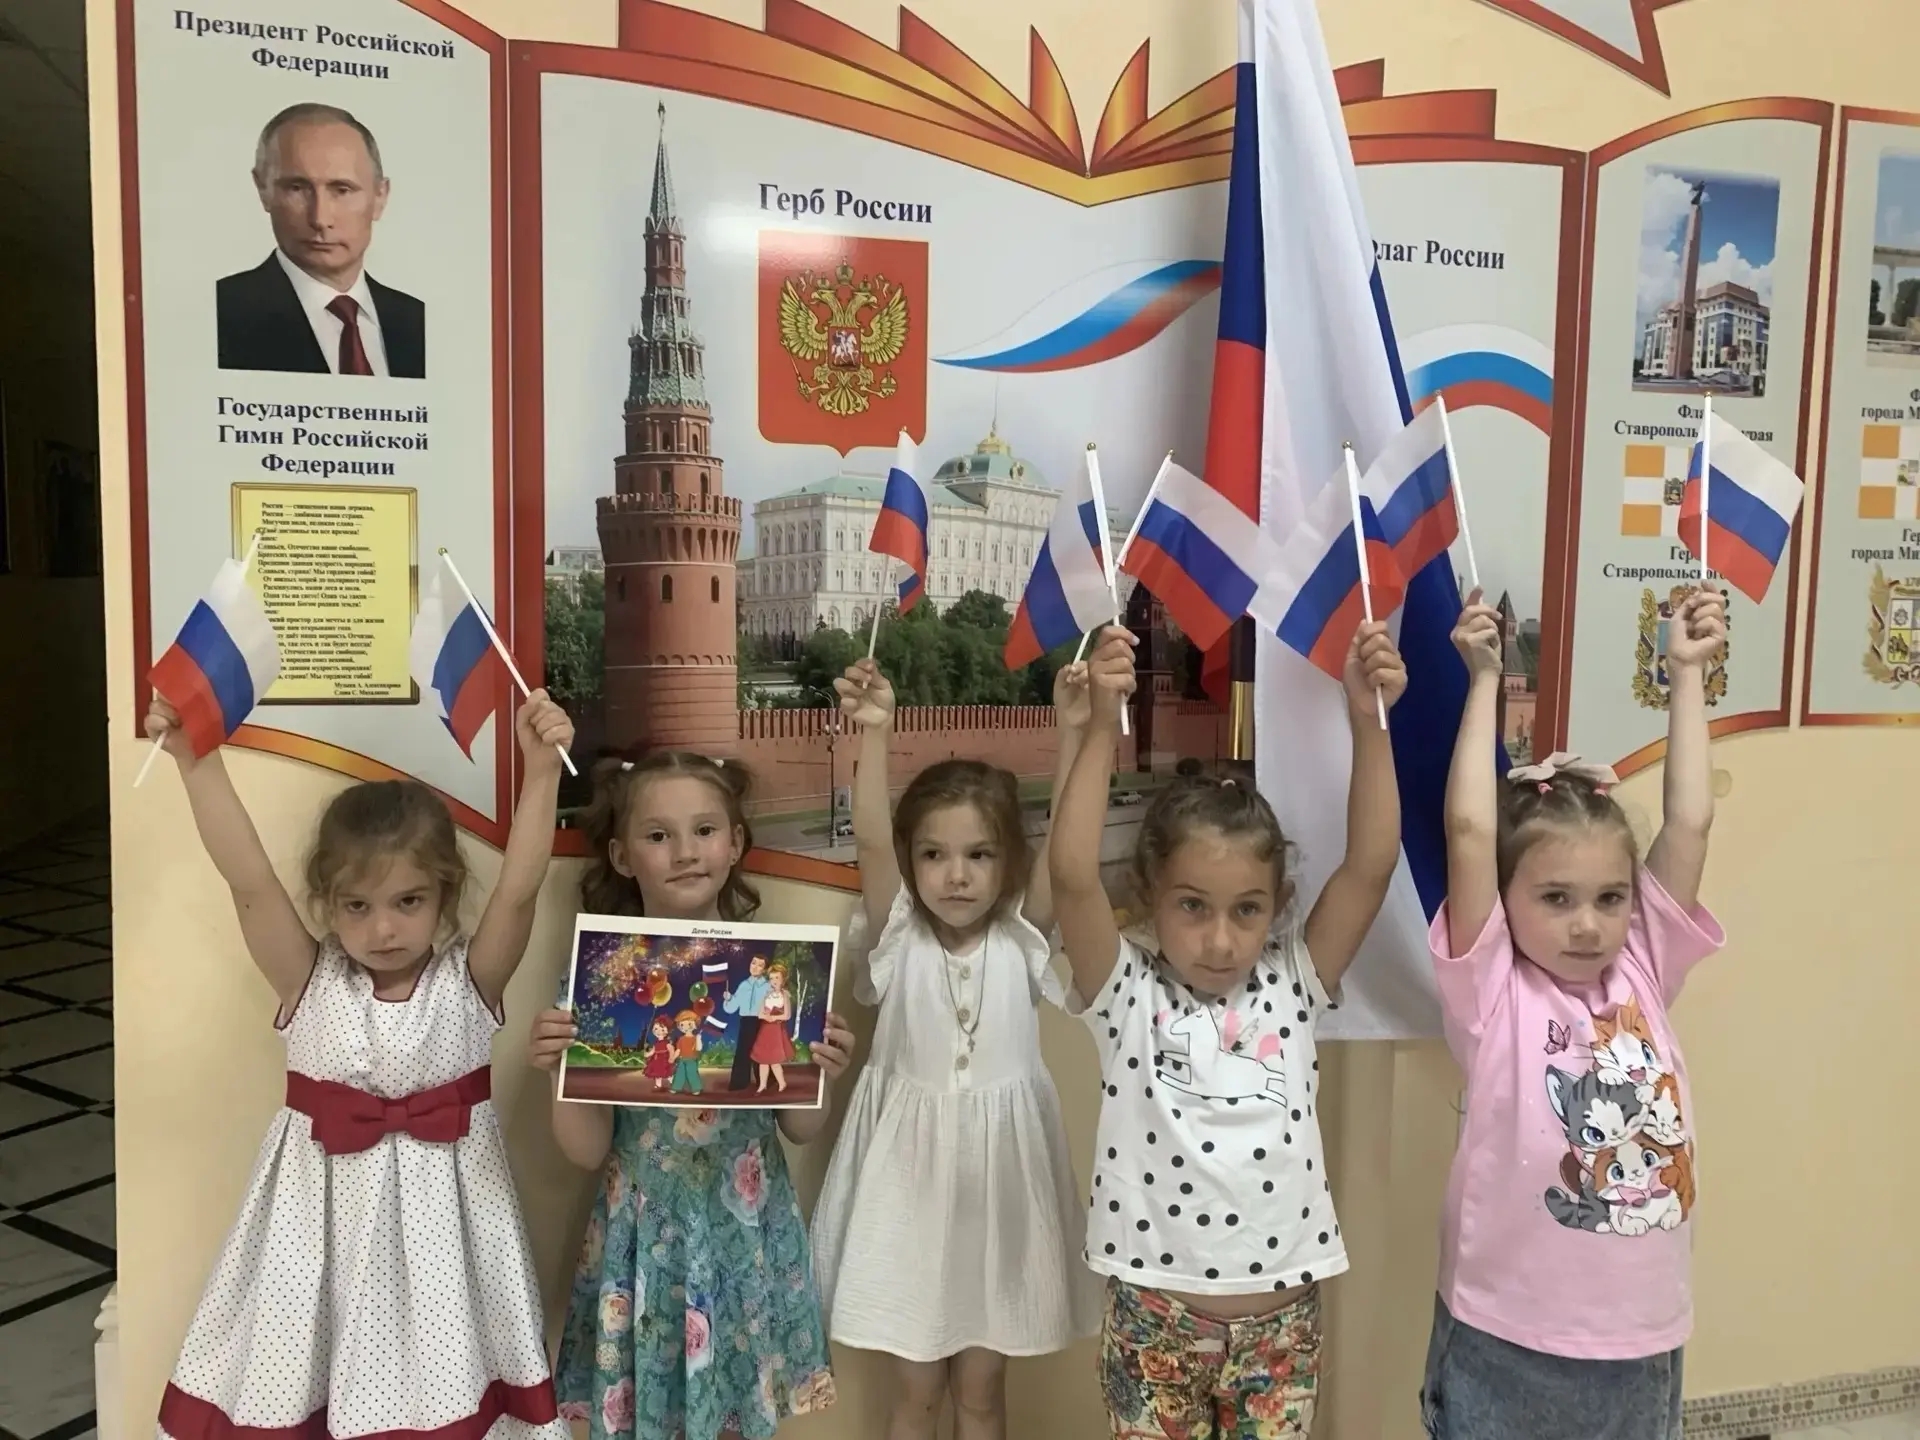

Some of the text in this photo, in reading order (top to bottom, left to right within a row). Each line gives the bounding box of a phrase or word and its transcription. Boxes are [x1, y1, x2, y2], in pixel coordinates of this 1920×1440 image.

[173, 9, 455, 60] Президент Российской
[250, 46, 390, 79] Федерации
[758, 182, 933, 224] Герб России
[1424, 239, 1505, 270] России
[216, 395, 429, 424] Государственный
[1860, 406, 1905, 423] города
[217, 423, 429, 451] Гимн Российской
[1613, 419, 1699, 440] Ставрополь
[260, 452, 395, 478] Федерации
[1669, 545, 1694, 565] Гер
[1850, 547, 1895, 563] города
